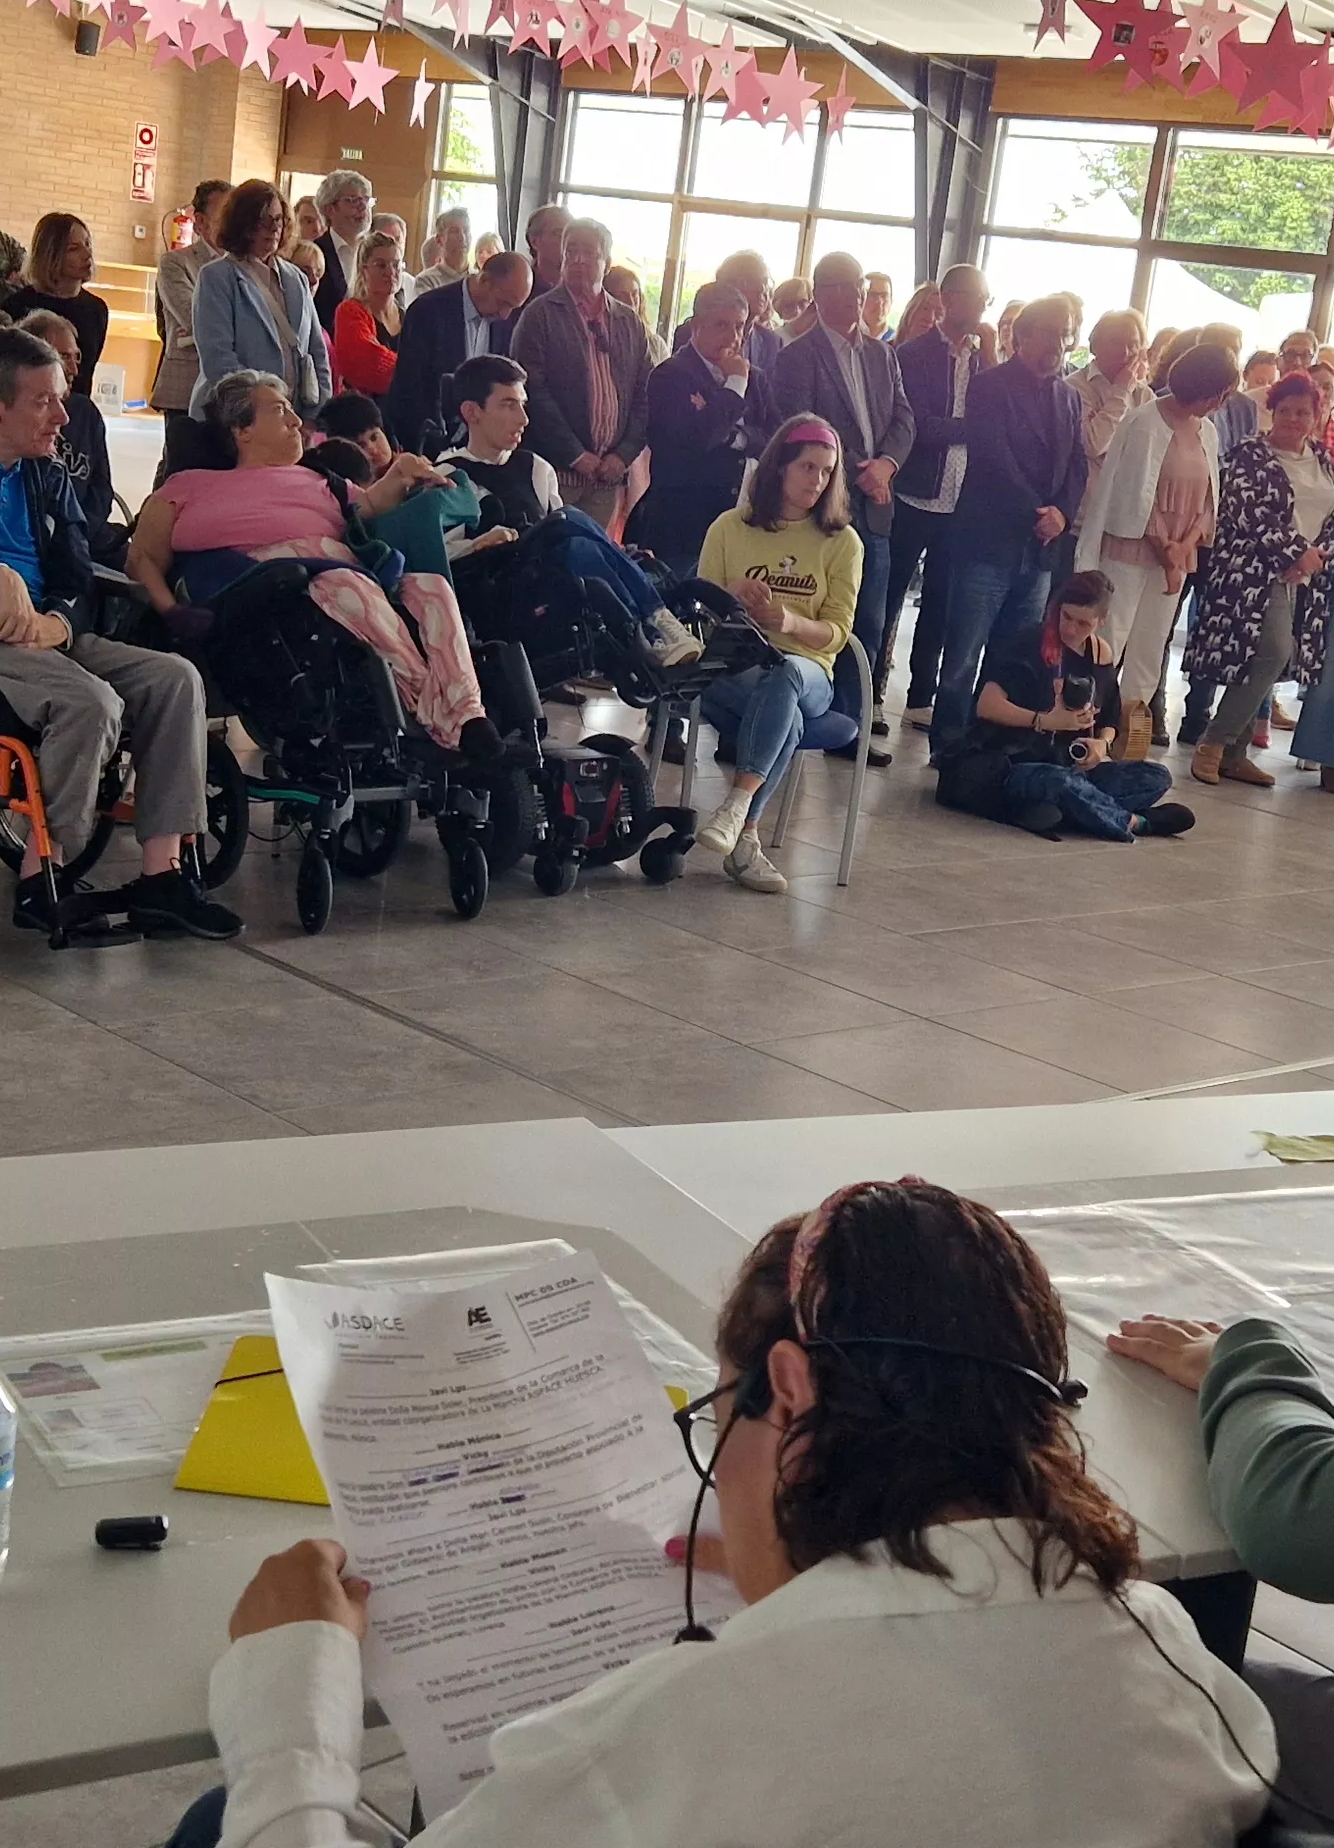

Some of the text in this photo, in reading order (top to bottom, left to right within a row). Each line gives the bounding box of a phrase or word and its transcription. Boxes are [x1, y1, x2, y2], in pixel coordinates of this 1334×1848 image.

[745, 564, 817, 595] Peanuts
[540, 1363, 581, 1383] Comarca
[582, 1358, 593, 1369] de
[527, 1382, 563, 1400] ASPACE
